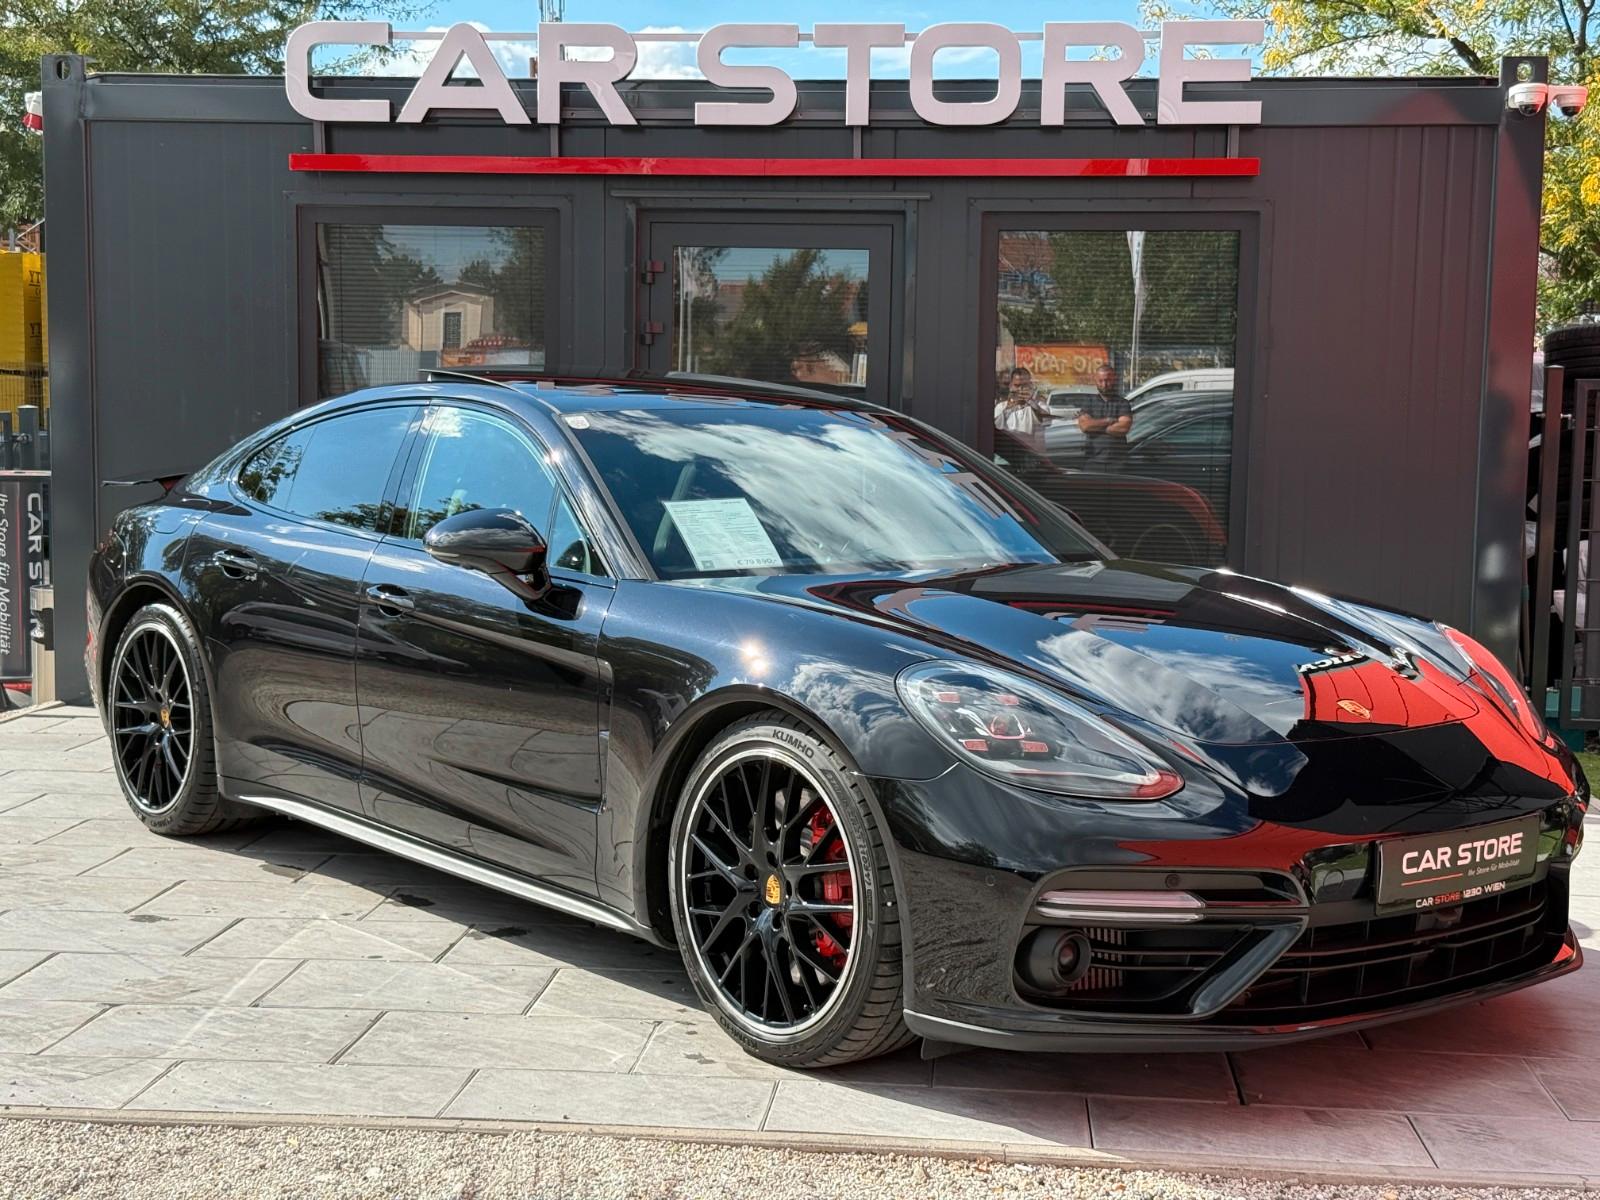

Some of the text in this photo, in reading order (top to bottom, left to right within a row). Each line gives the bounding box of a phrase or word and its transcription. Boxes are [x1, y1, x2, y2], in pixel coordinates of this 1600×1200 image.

[286, 20, 1265, 126] CAR STORE
[28, 493, 42, 553] CAR
[0, 494, 11, 655] Ihr Store für Mobilität
[771, 728, 815, 760] KUMHO
[1402, 832, 1523, 875] CAR STORE
[1415, 881, 1506, 908] CAR STORE 1230 WIEN
[719, 1016, 759, 1050] KUMHO
